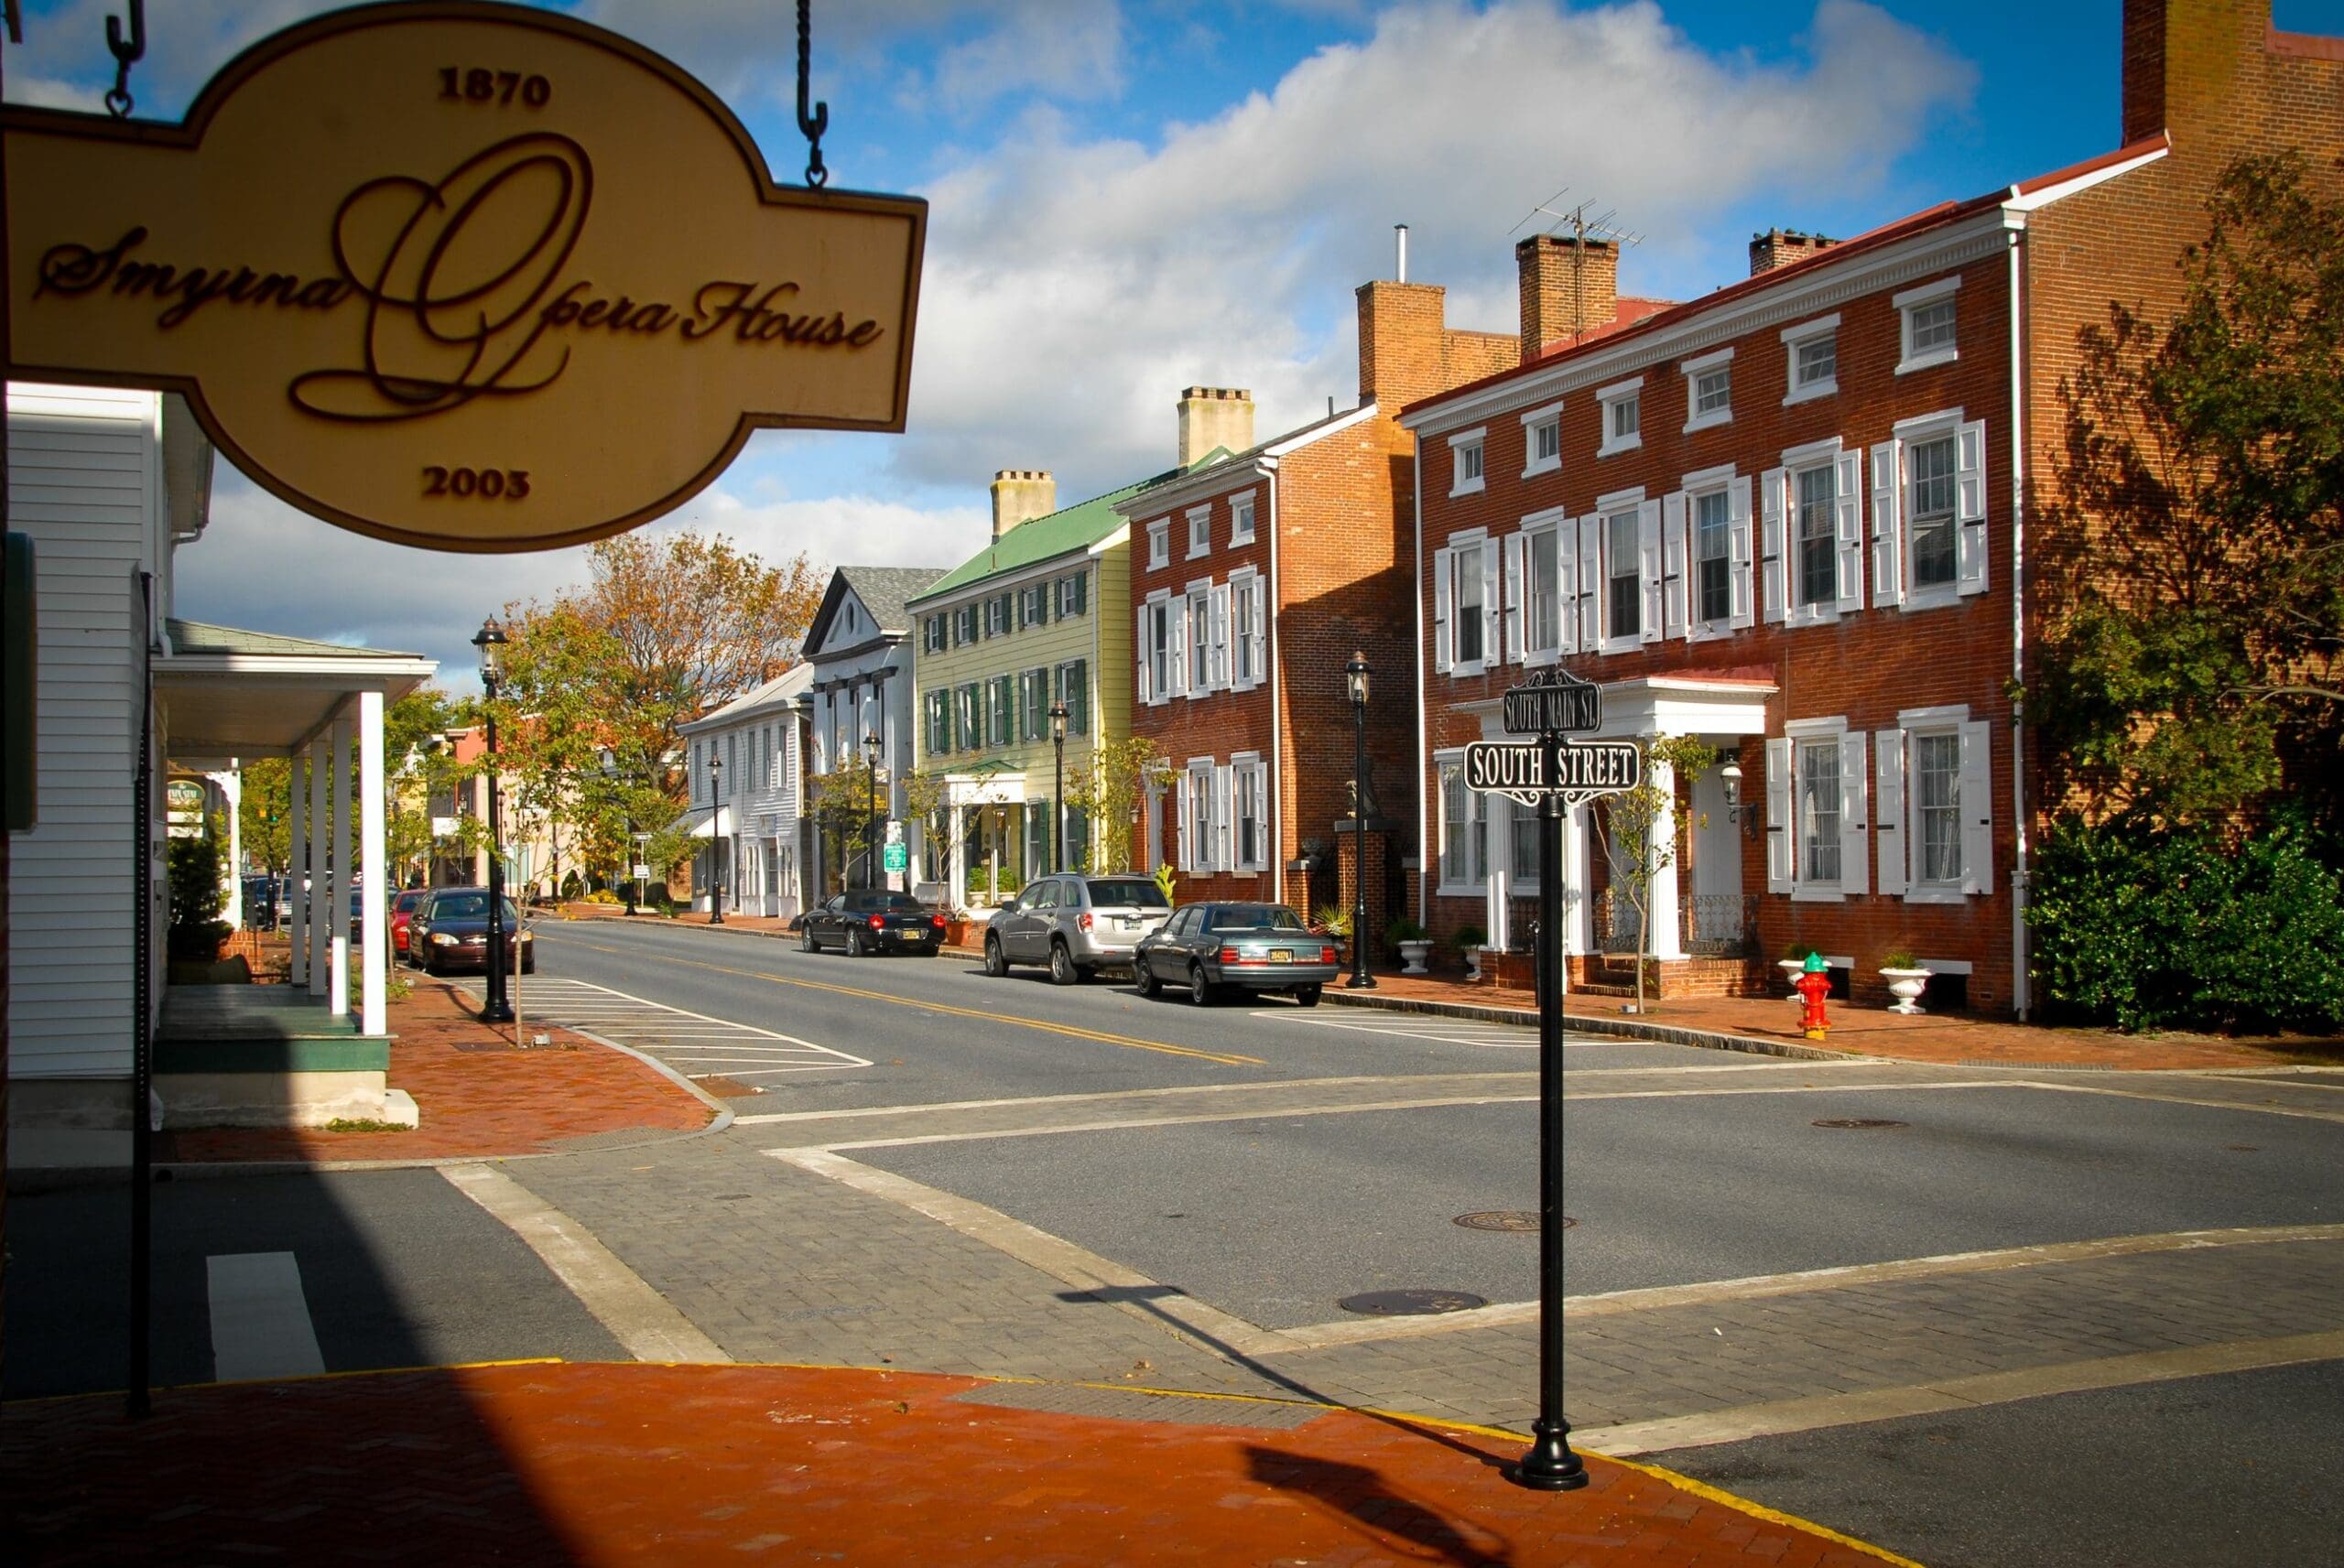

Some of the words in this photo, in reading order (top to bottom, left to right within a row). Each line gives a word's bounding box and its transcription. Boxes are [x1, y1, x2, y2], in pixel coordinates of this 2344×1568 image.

[438, 66, 551, 108] 1870
[33, 227, 353, 328] Smyrna
[288, 131, 681, 423] Opera
[681, 281, 884, 350] House
[420, 466, 531, 500] 2003
[1505, 693, 1542, 731] SOUTH
[1546, 689, 1576, 729] MAIN
[1473, 747, 1544, 785] SOUTH
[1557, 747, 1633, 785] STREET
